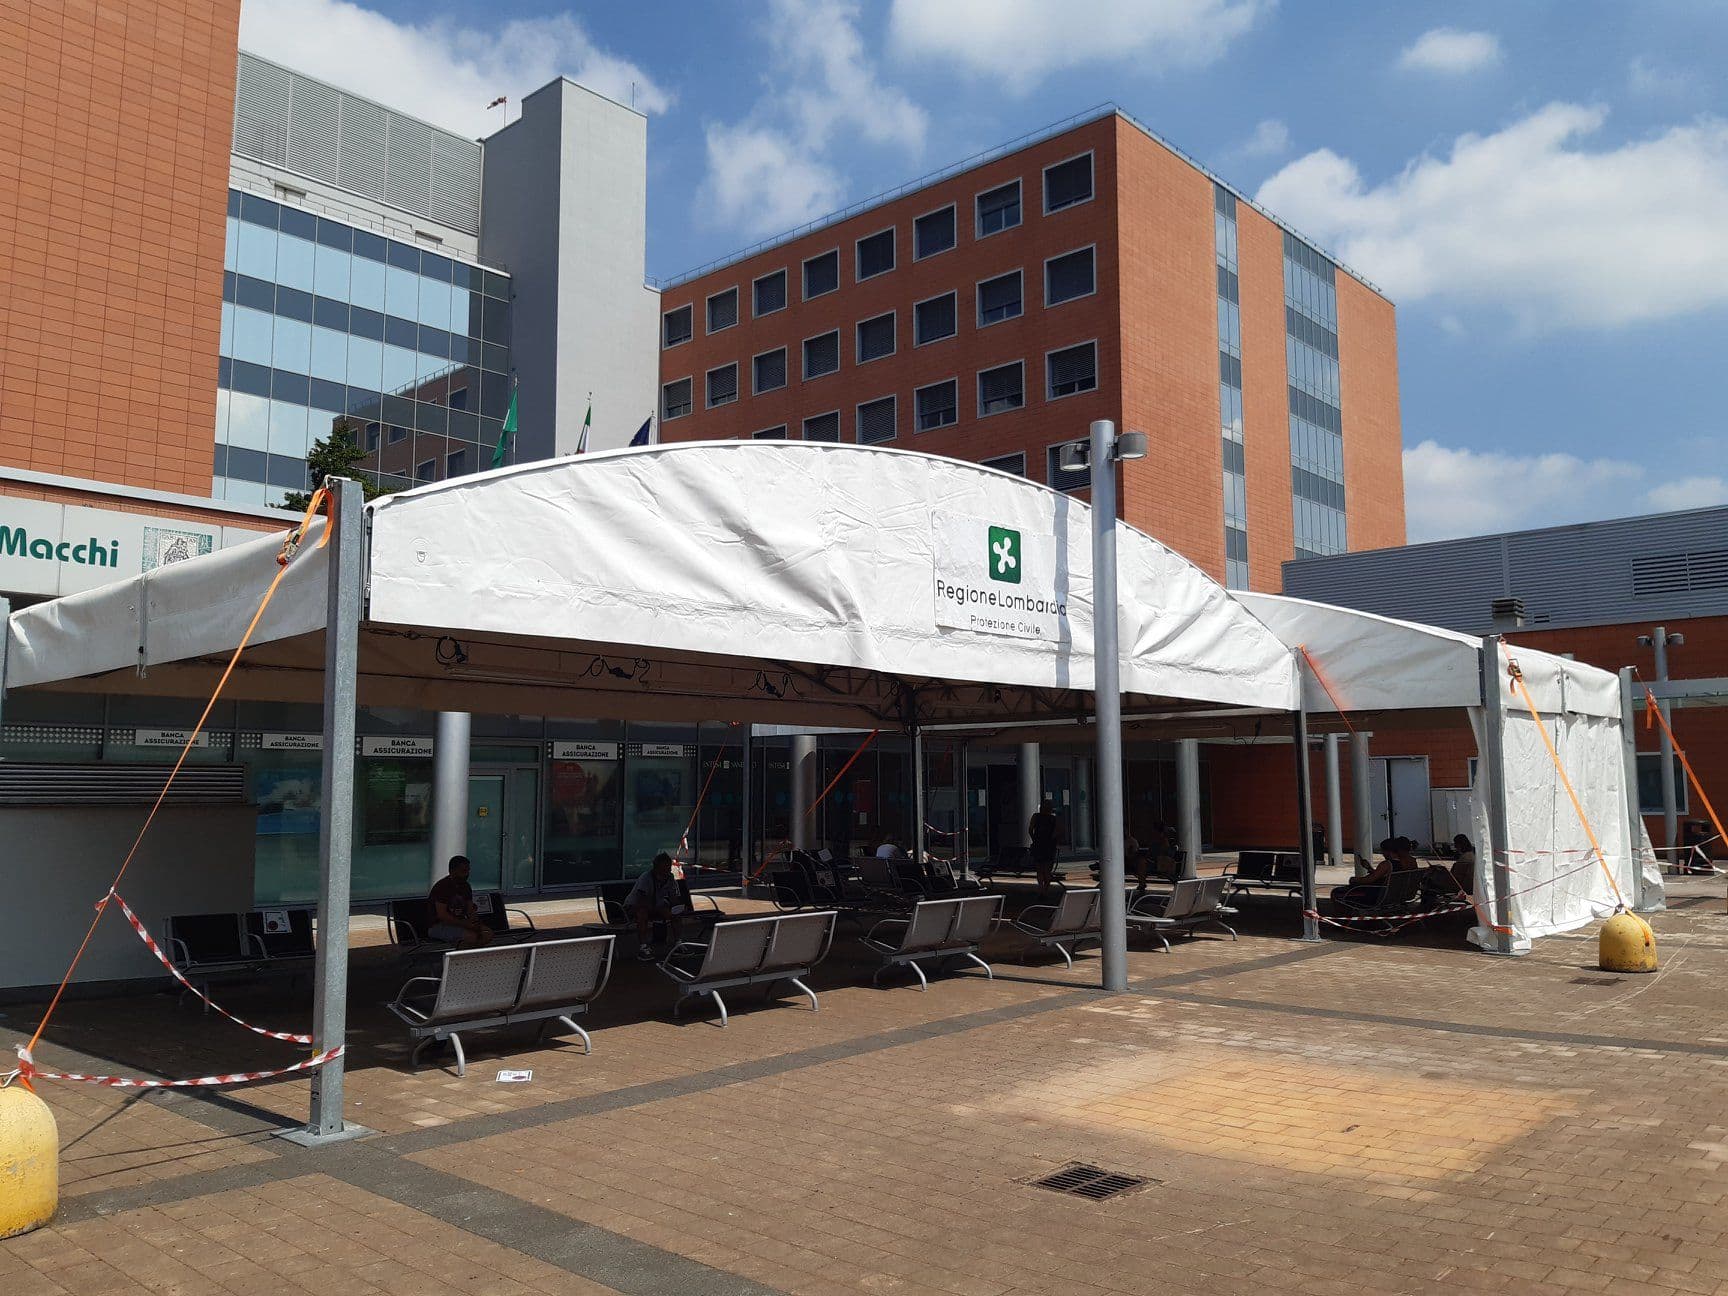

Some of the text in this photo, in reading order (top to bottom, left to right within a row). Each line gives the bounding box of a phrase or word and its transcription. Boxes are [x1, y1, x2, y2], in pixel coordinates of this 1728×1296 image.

[0, 525, 120, 568] Macchi
[970, 614, 1041, 634] Protezione Civile
[373, 747, 433, 755] ASSICURAZIONE
